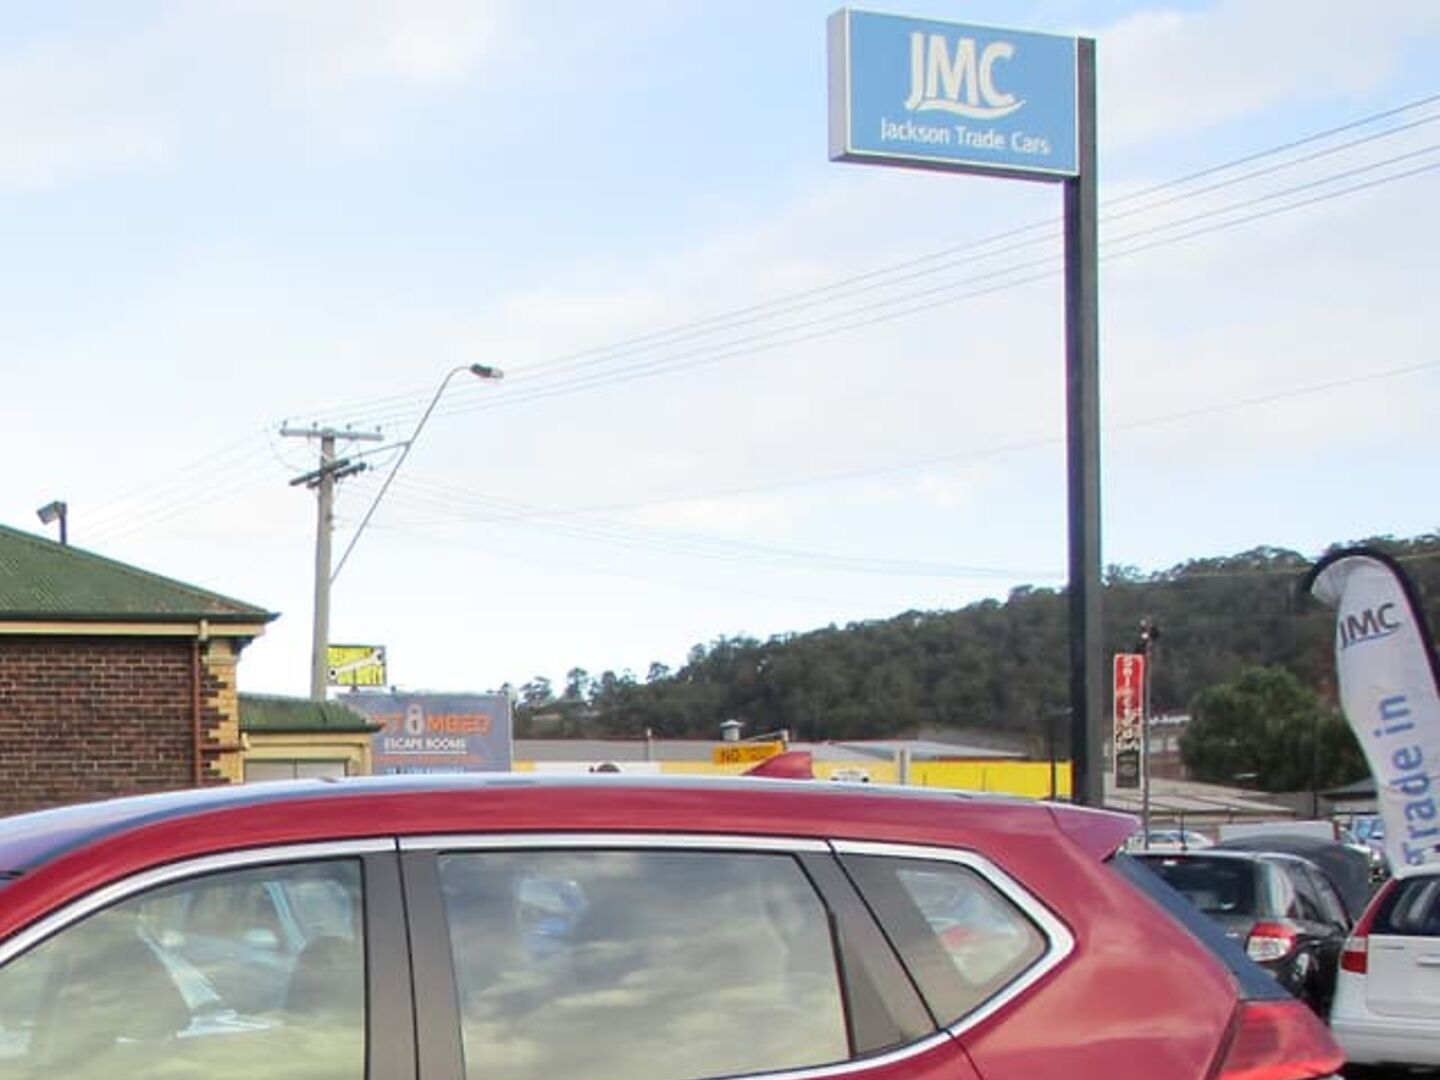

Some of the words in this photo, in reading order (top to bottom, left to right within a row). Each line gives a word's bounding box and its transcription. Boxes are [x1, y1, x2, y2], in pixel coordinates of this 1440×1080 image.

[904, 31, 1016, 111] JMC
[880, 118, 950, 145] Jackson
[955, 126, 1006, 149] Trade
[1011, 131, 1053, 155] Cars
[1337, 602, 1403, 649] JMC
[1373, 695, 1415, 738] in
[383, 737, 424, 750] ESCAPE
